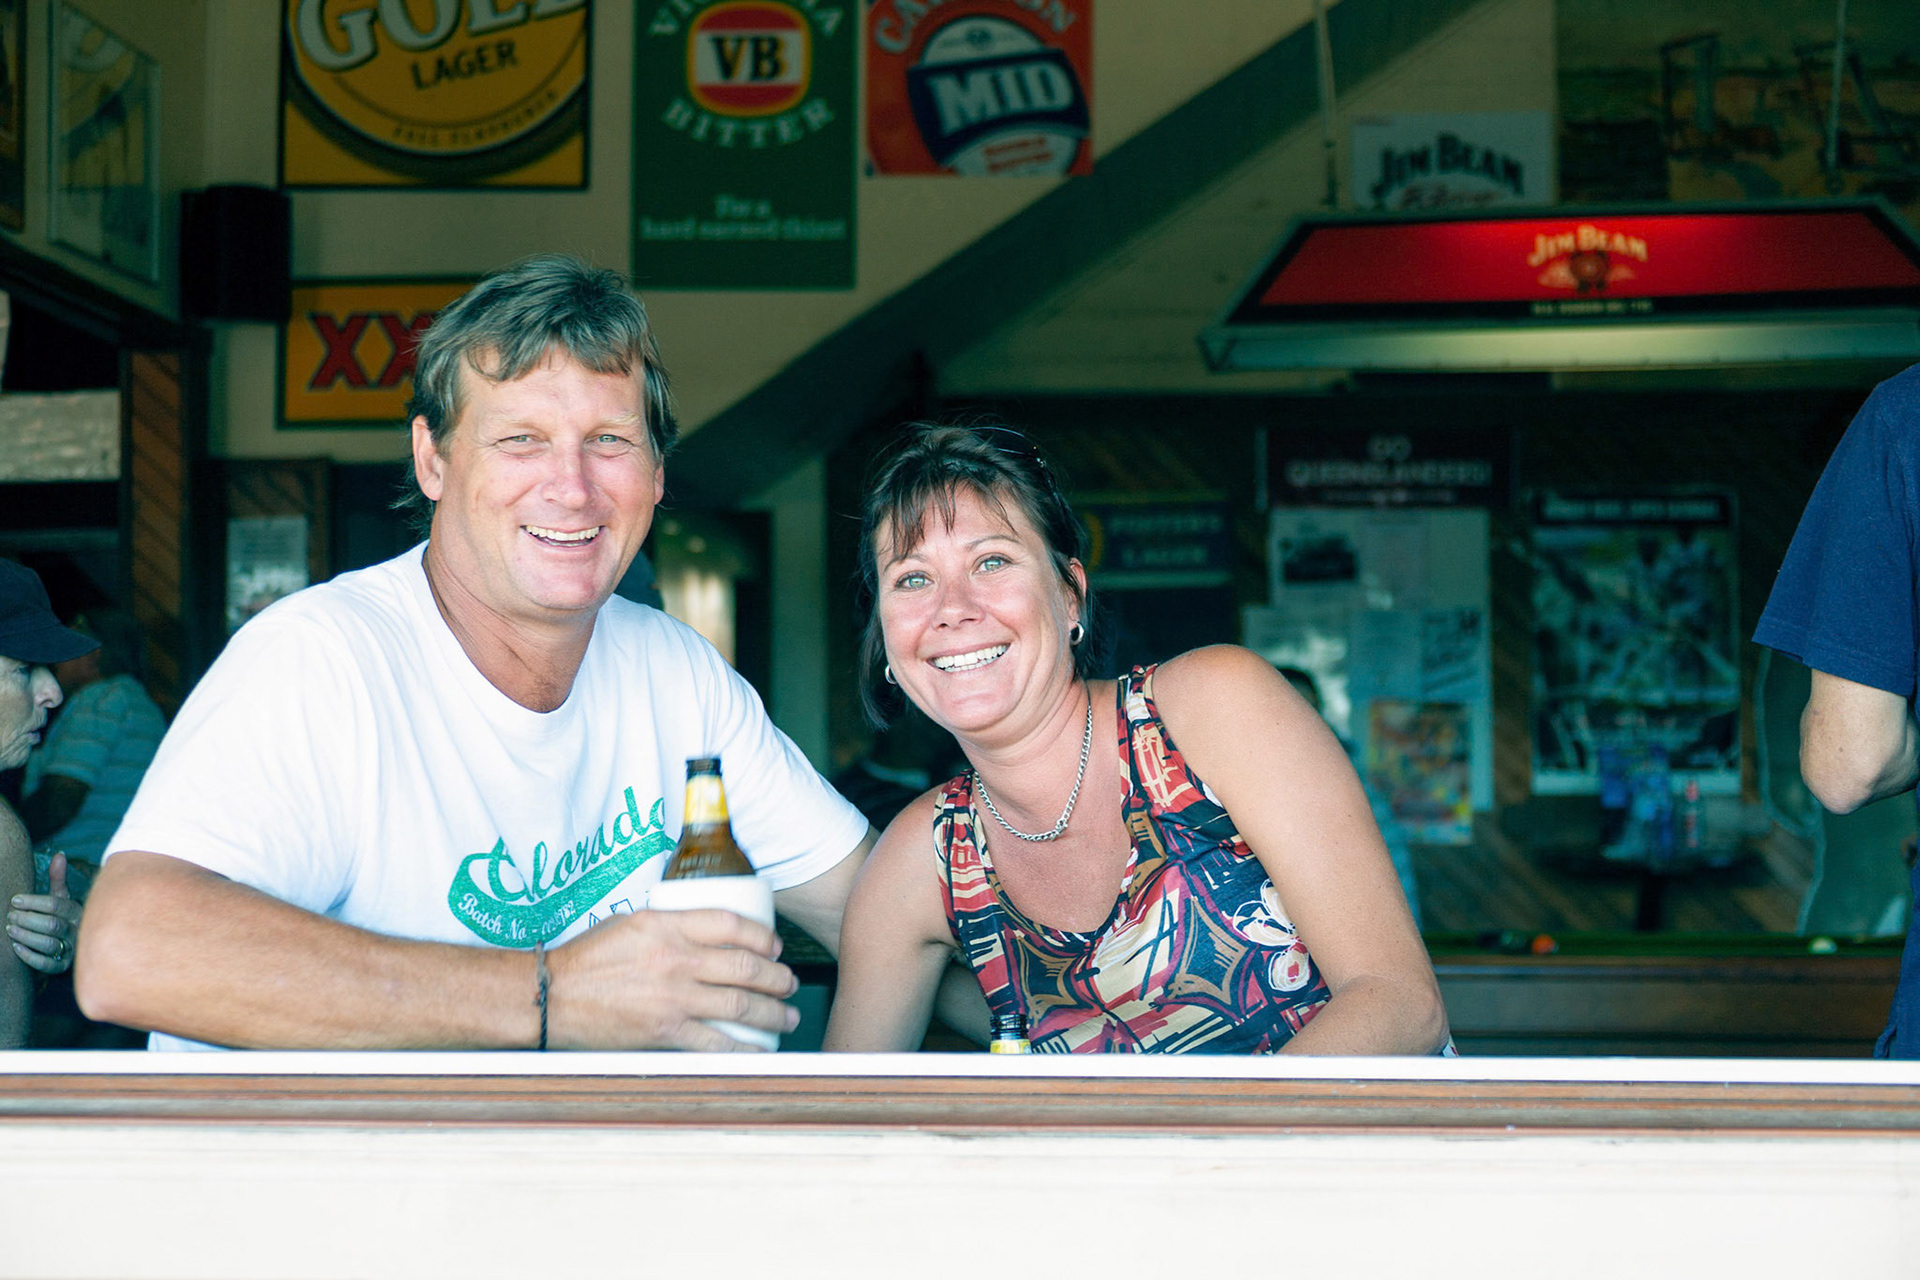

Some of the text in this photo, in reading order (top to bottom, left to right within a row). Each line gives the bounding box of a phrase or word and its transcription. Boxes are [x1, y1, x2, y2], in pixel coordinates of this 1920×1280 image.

[411, 39, 519, 90] LAGER
[711, 34, 787, 82] VB
[927, 60, 1075, 137] MID
[662, 99, 834, 148] BITTER
[1370, 146, 1431, 203] JIM
[1436, 131, 1525, 196] BEAM
[1527, 223, 1649, 267] JIM BEAM
[458, 893, 502, 935] Batch
